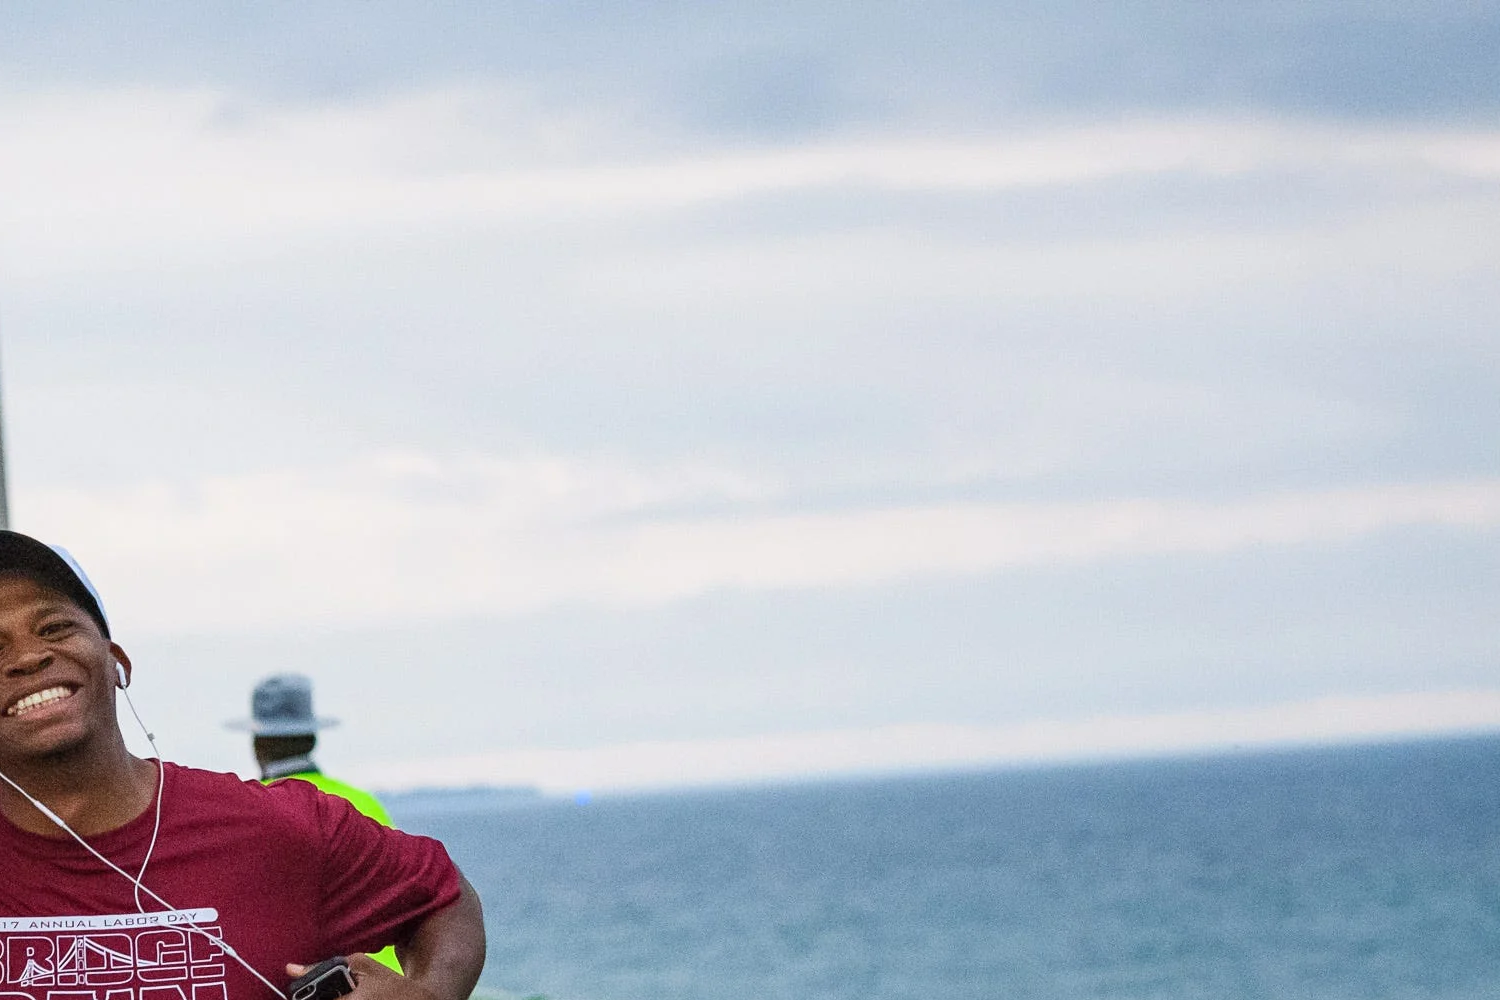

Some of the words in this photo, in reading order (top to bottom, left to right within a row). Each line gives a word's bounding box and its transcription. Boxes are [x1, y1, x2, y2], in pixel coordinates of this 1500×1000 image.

[29, 919, 98, 929] ANNUAL
[104, 916, 159, 927] LABOR
[167, 912, 199, 922] DAY
